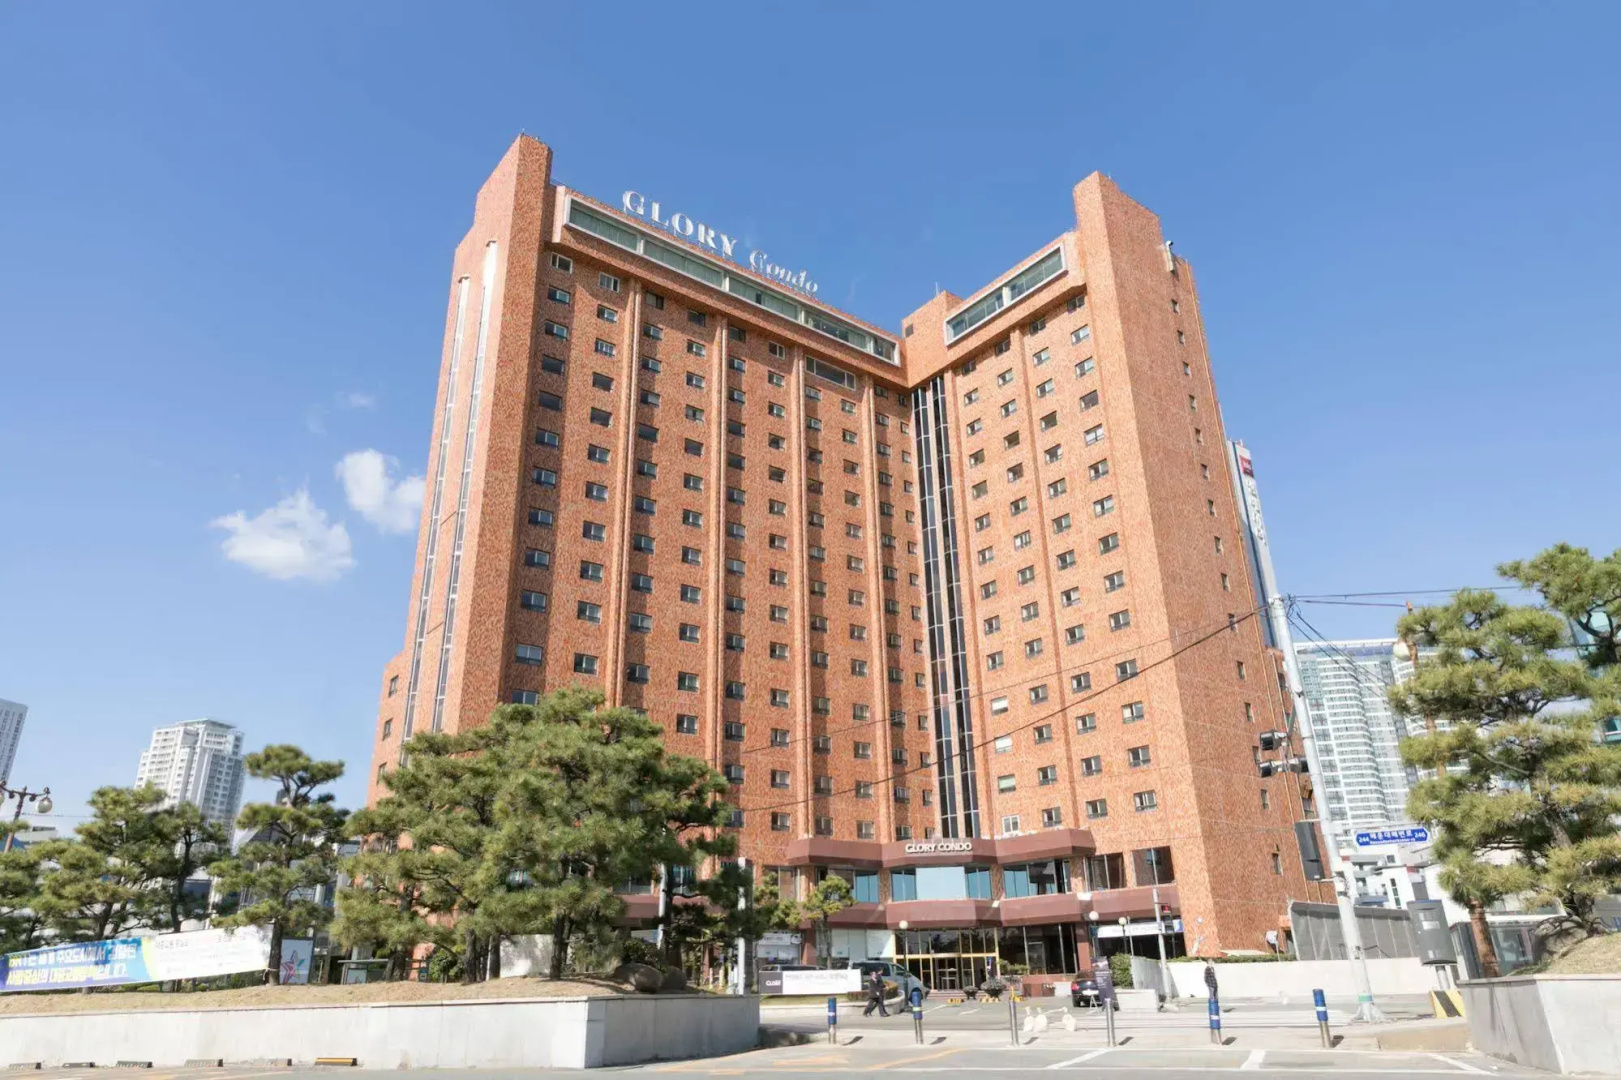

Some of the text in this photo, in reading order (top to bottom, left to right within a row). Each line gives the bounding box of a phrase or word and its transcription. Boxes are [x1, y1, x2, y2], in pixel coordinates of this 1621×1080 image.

[622, 189, 818, 294] GLORY Condo
[905, 842, 972, 853] GLORY CONDO
